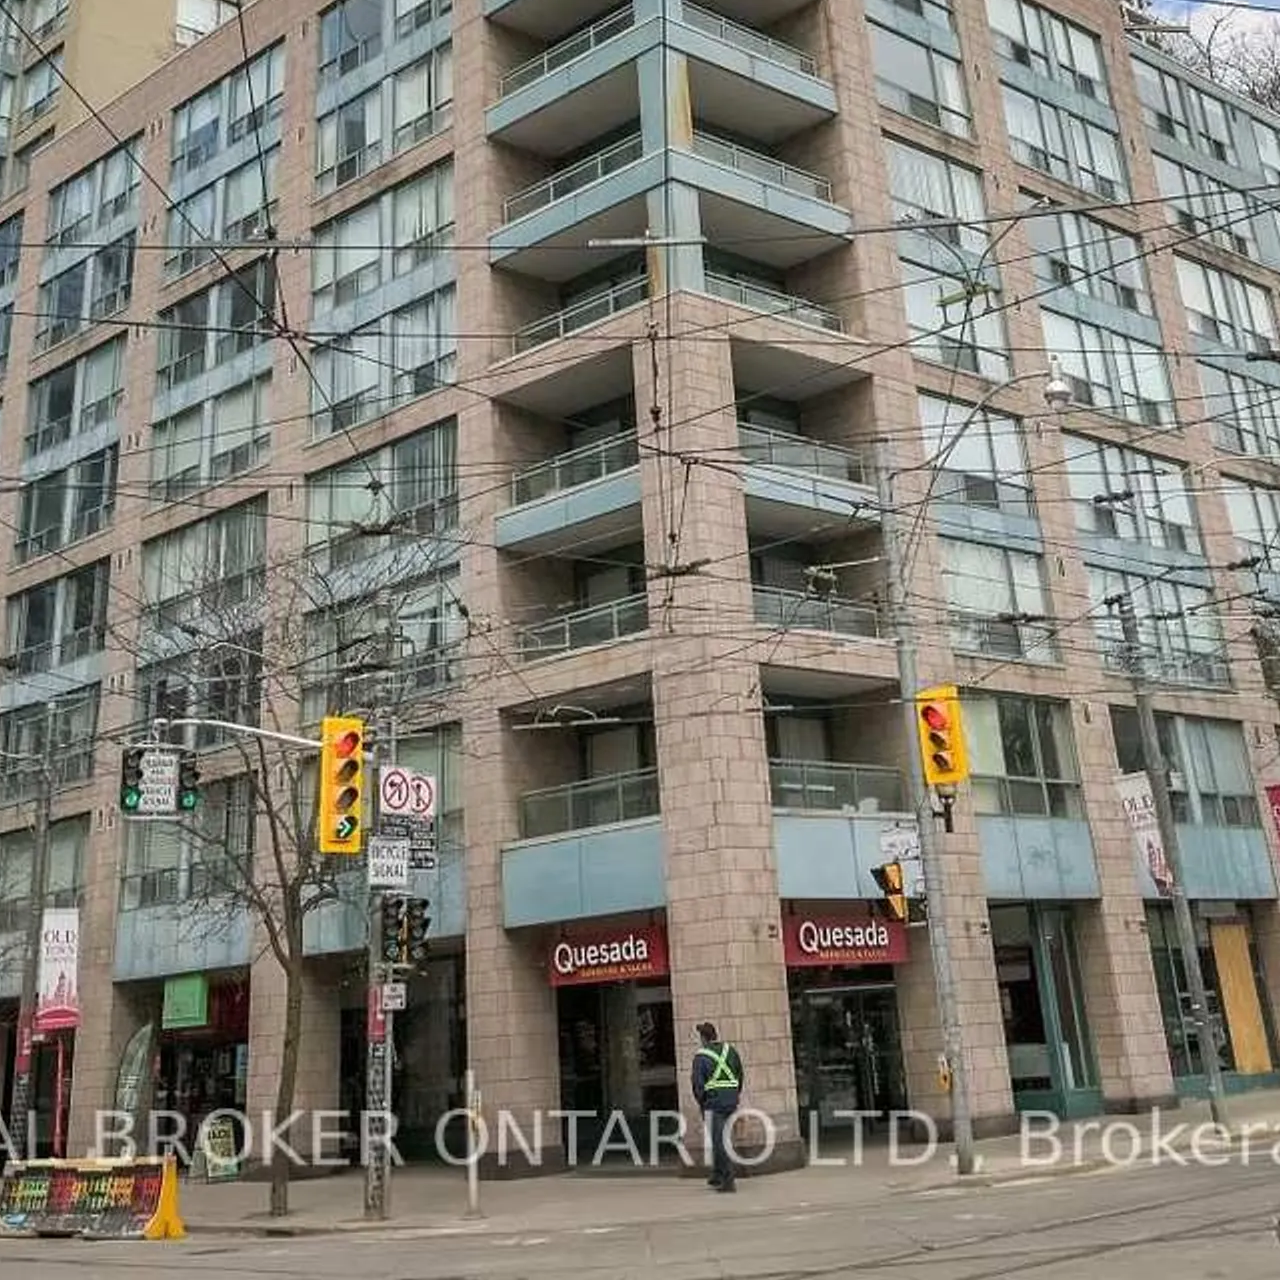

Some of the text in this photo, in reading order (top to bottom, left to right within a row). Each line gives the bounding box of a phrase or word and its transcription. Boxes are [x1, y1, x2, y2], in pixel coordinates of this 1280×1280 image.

[44, 929, 77, 944] OLD
[799, 920, 890, 953] Quesada
[554, 934, 648, 974] Quesada
